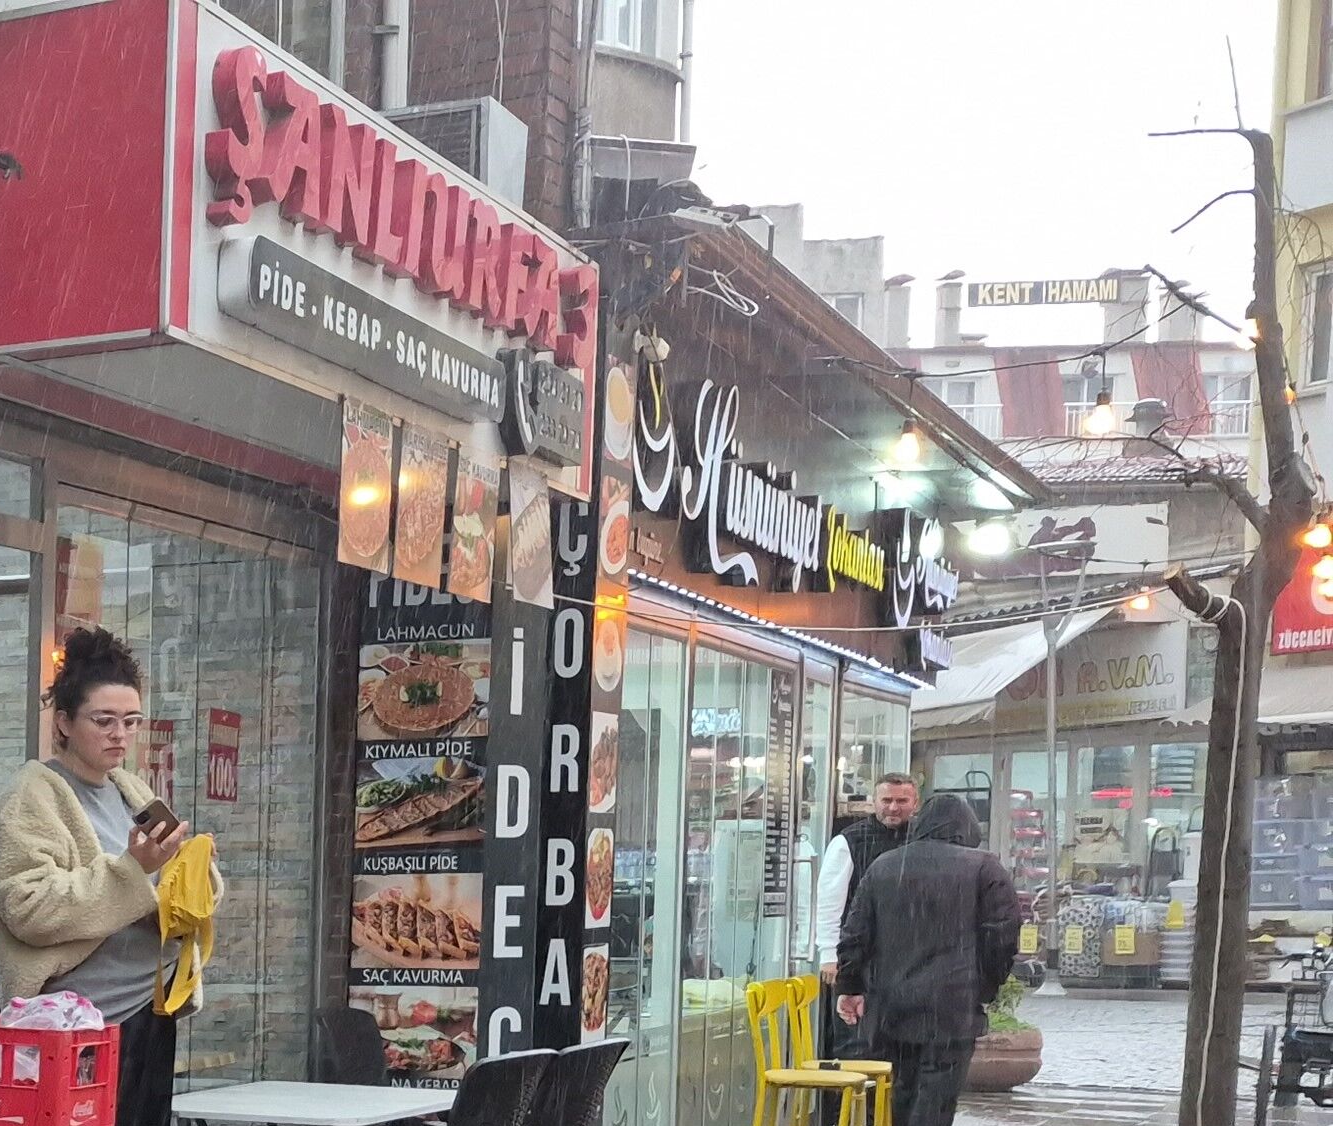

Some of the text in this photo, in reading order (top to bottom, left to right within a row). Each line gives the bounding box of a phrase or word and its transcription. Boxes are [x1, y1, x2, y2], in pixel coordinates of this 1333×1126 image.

[205, 45, 558, 351] ŞANLIURFA
[977, 279, 1118, 305] KENT HAMAMI
[259, 261, 500, 409] PİDE KEBAP SAÇ KAVURMA
[377, 623, 475, 642] LAHMACUN
[365, 738, 473, 759] KIYMALI PİDE
[363, 852, 459, 874] KUŞBAŞILI PİDE
[363, 969, 464, 985] SAÇ KAVURMA
